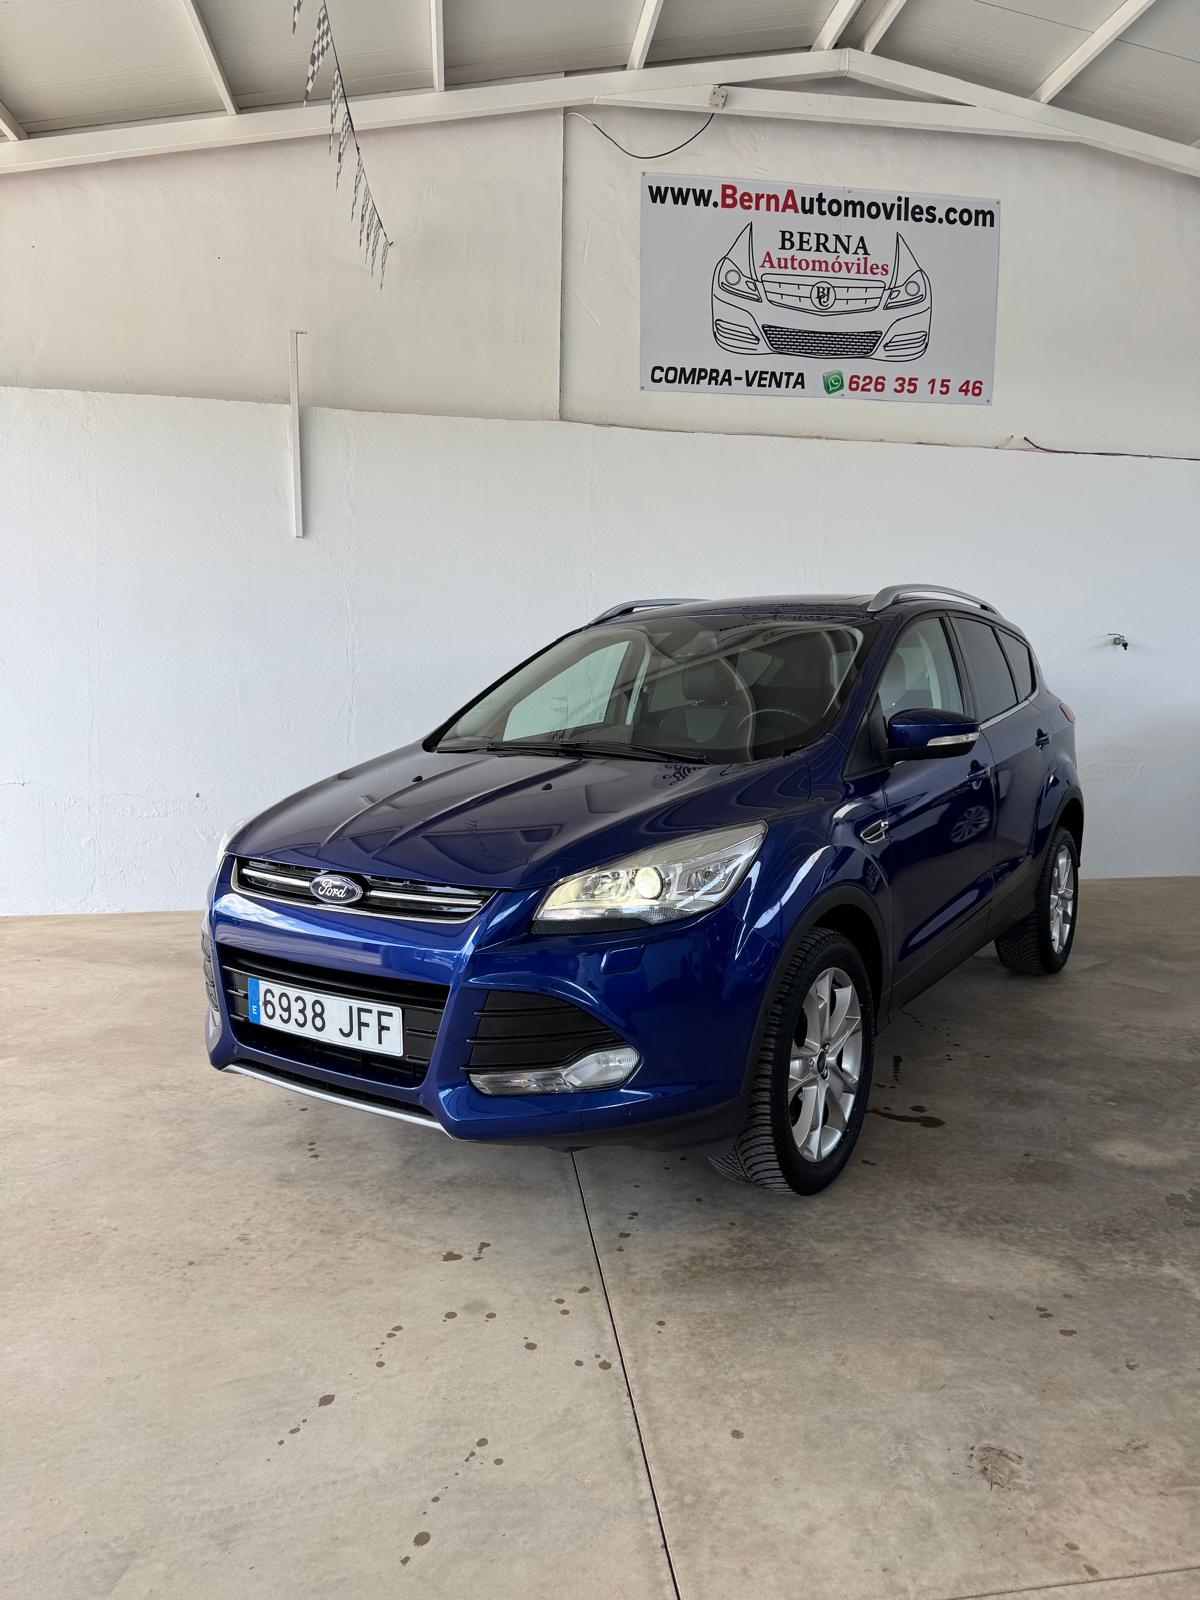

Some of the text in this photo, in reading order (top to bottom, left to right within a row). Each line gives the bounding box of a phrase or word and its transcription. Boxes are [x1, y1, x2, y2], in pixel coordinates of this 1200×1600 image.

[648, 184, 995, 228] www.BernAutomoviles.com
[778, 230, 871, 256] BERNA
[759, 251, 890, 276] Automóviles
[650, 365, 806, 390] COMPRA-VENTA
[848, 374, 984, 397] 626 35 15 46
[318, 878, 347, 899] Ford
[252, 988, 394, 1045] E 6938 JFF
